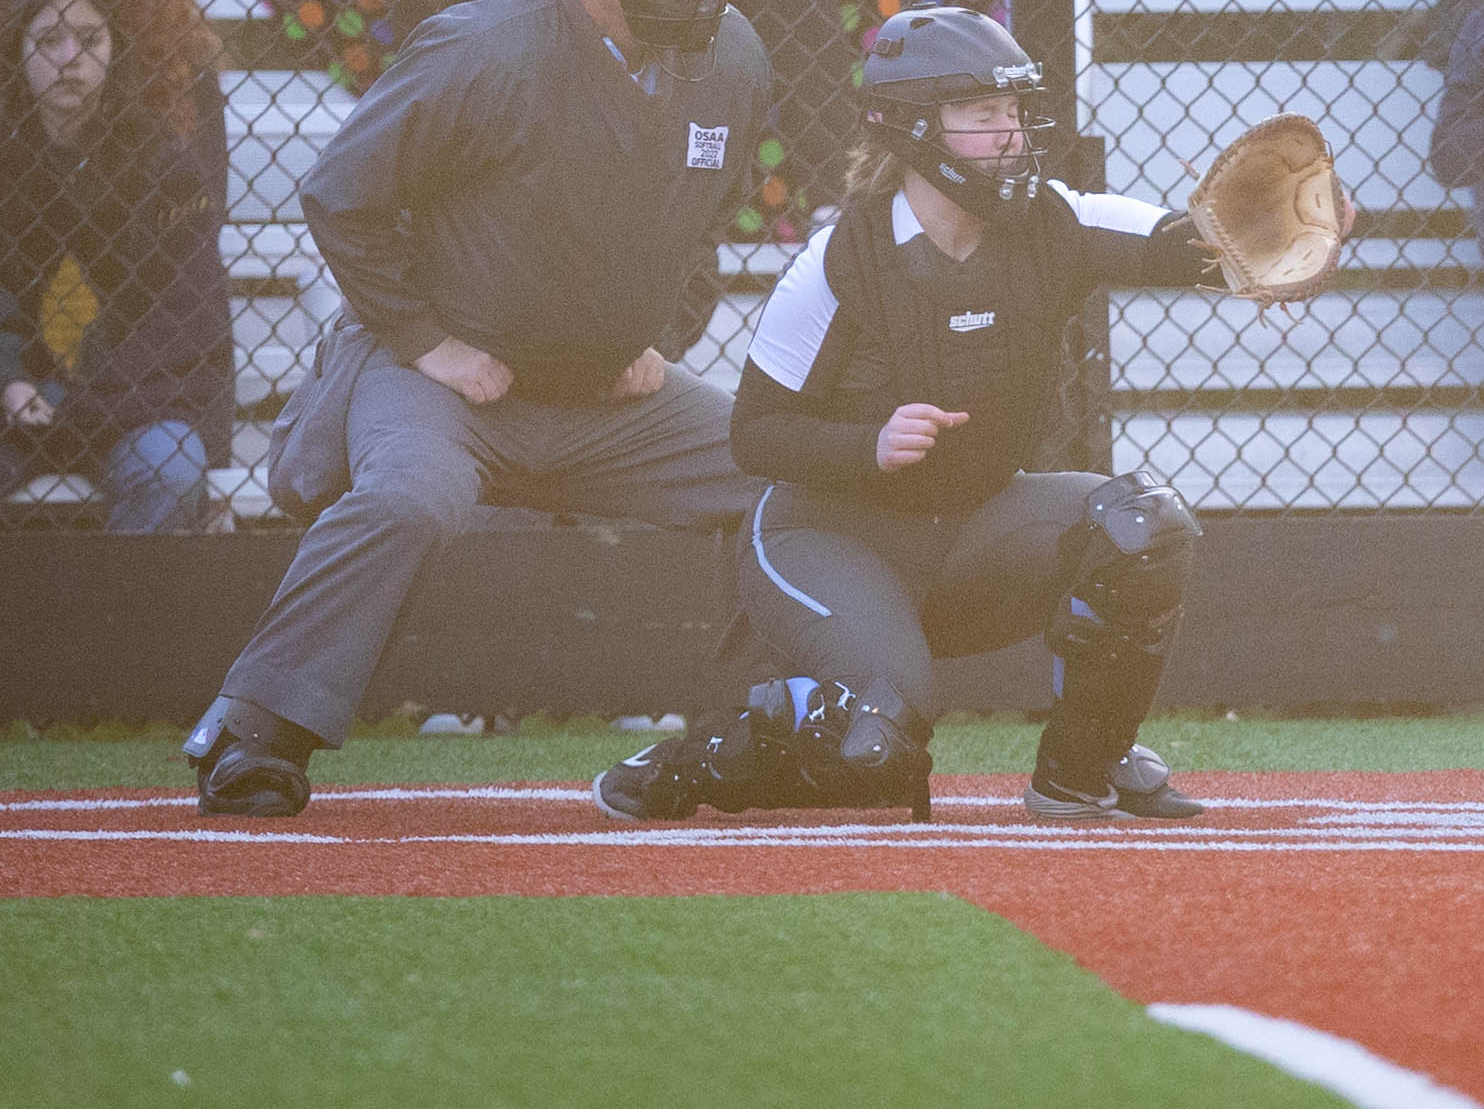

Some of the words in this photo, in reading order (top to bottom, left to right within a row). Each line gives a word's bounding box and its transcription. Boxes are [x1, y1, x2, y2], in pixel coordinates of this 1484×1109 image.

[695, 130, 724, 142] OSAA
[700, 149, 719, 158] 2022
[691, 157, 720, 168] OFFICIAL
[949, 311, 995, 328] schutt
